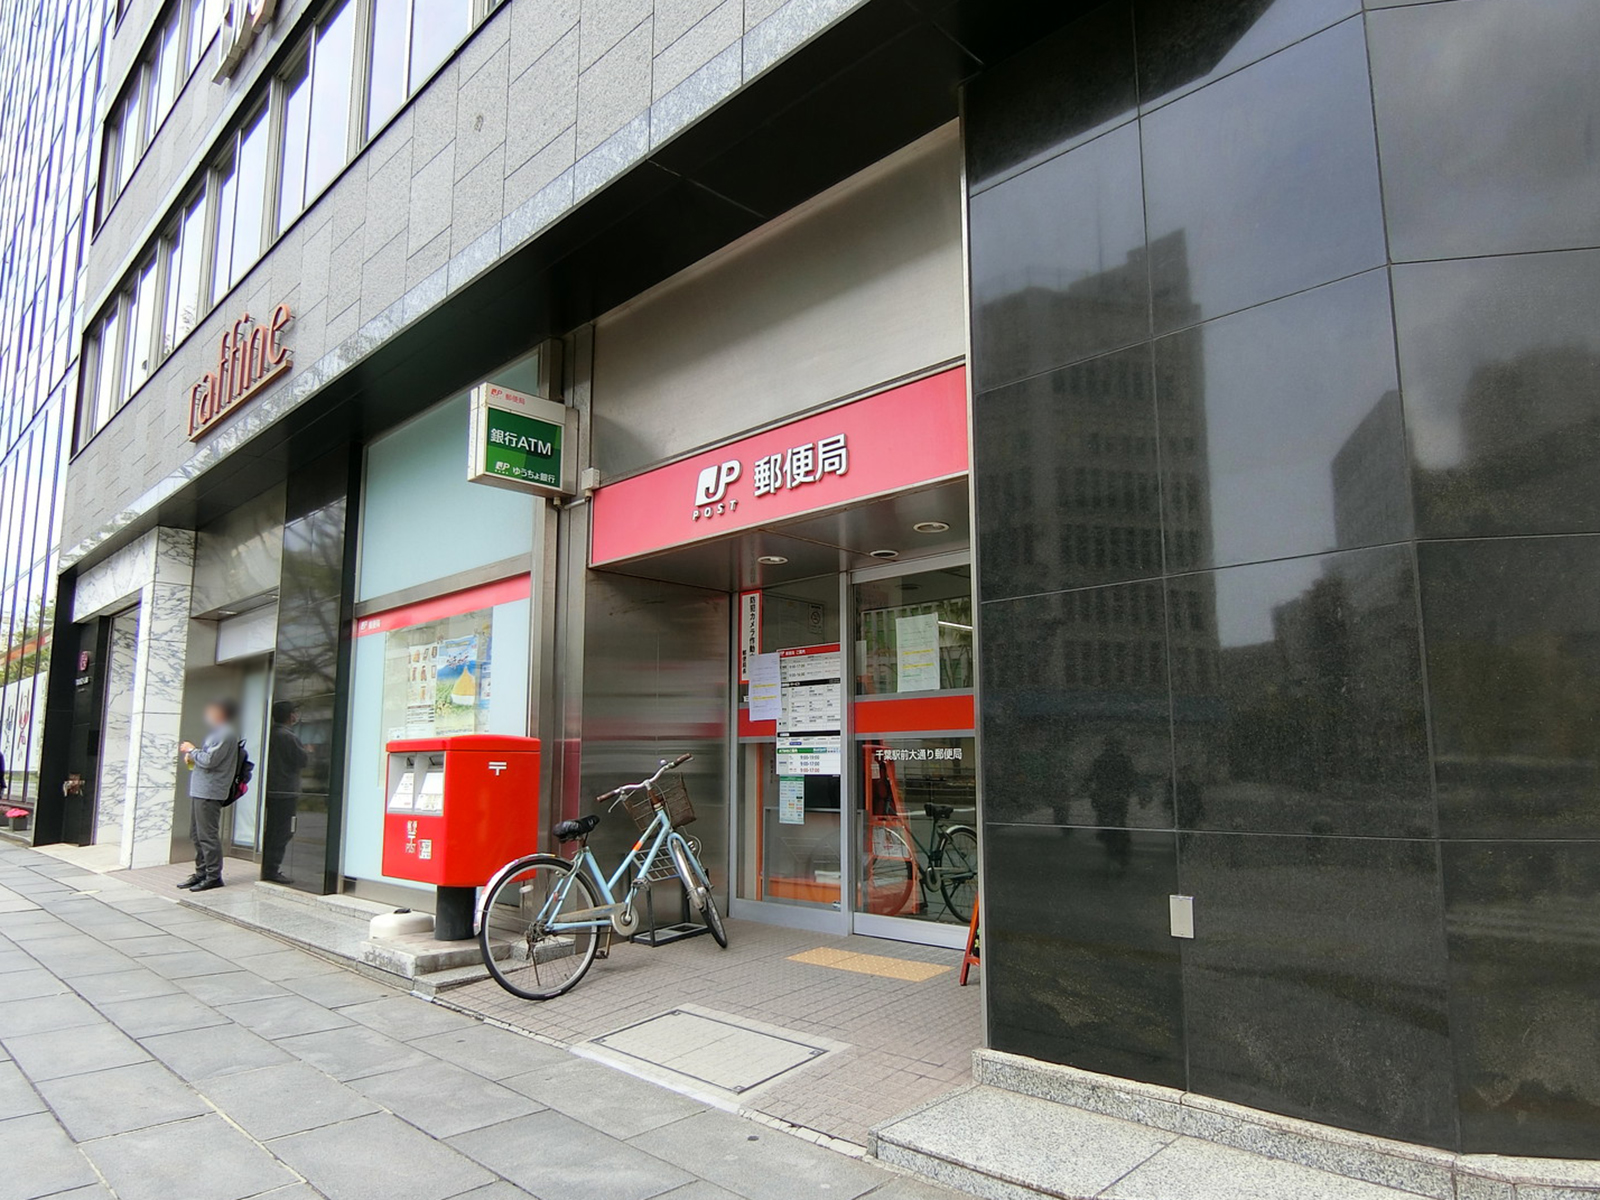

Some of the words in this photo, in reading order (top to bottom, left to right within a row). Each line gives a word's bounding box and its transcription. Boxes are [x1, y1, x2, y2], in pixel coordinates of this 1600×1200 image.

[188, 303, 292, 437] raffine
[490, 428, 552, 456] 銀行ATM
[512, 466, 556, 484] ゆうちょ銀行
[753, 433, 849, 497] 郵便局
[692, 500, 738, 521] POST
[875, 748, 963, 761] 千葉駅前大通り郵便局
